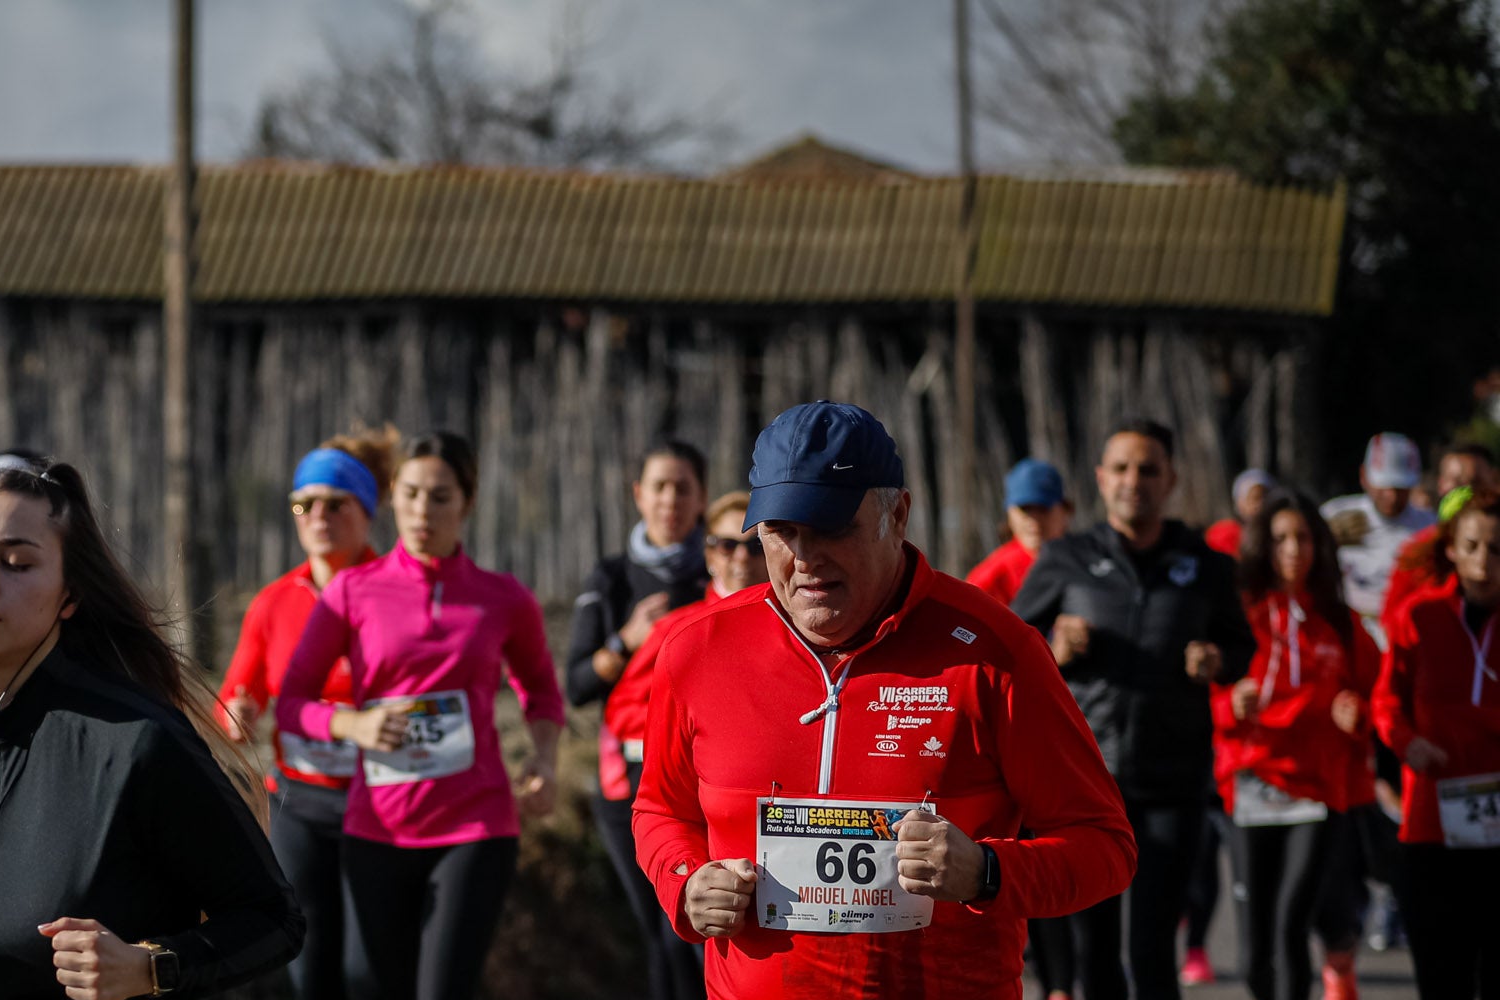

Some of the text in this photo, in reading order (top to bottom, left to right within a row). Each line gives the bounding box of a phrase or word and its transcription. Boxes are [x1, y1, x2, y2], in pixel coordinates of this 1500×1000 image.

[879, 687, 896, 703] VII
[896, 686, 948, 695] CARRERA
[895, 694, 948, 702] POPULAR
[867, 701, 955, 712] Ruta de los secaderos
[899, 715, 932, 726] olimpo
[934, 751, 946, 759] Vega
[766, 807, 783, 819] 26
[795, 807, 809, 825] VII
[808, 808, 869, 819] CARRERA
[809, 819, 869, 828] POPULAR
[766, 825, 841, 835] Ruta de los Secaderos
[816, 841, 877, 885] 66
[798, 886, 897, 906] MIGUEL ANGEL
[841, 910, 875, 921] olimpo
